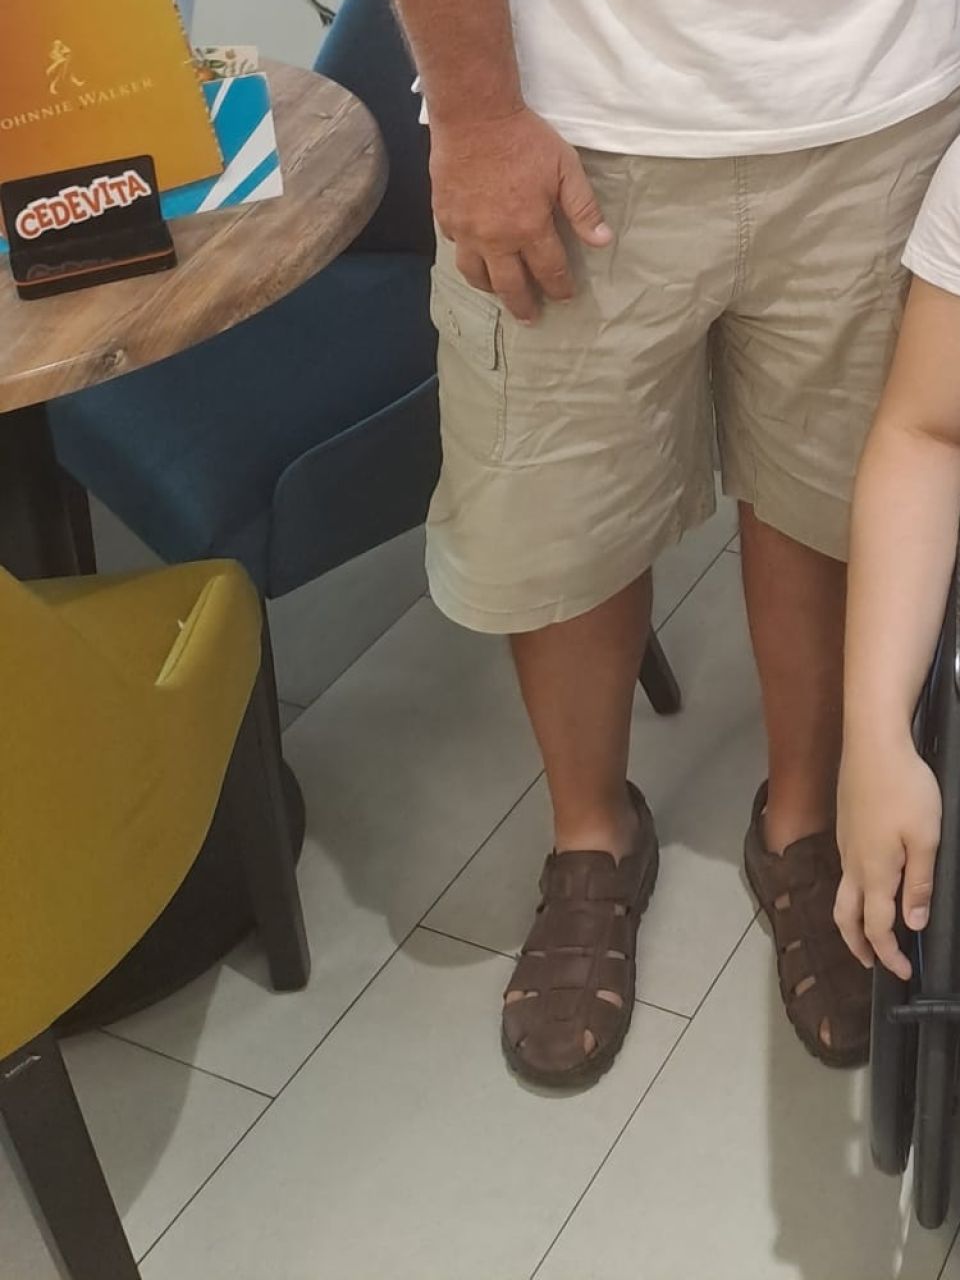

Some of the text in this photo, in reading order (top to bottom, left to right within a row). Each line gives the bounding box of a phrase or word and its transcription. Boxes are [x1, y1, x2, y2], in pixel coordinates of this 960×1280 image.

[0, 77, 153, 130] OHNNIE WALKER
[17, 172, 150, 238] CEDEVITA
